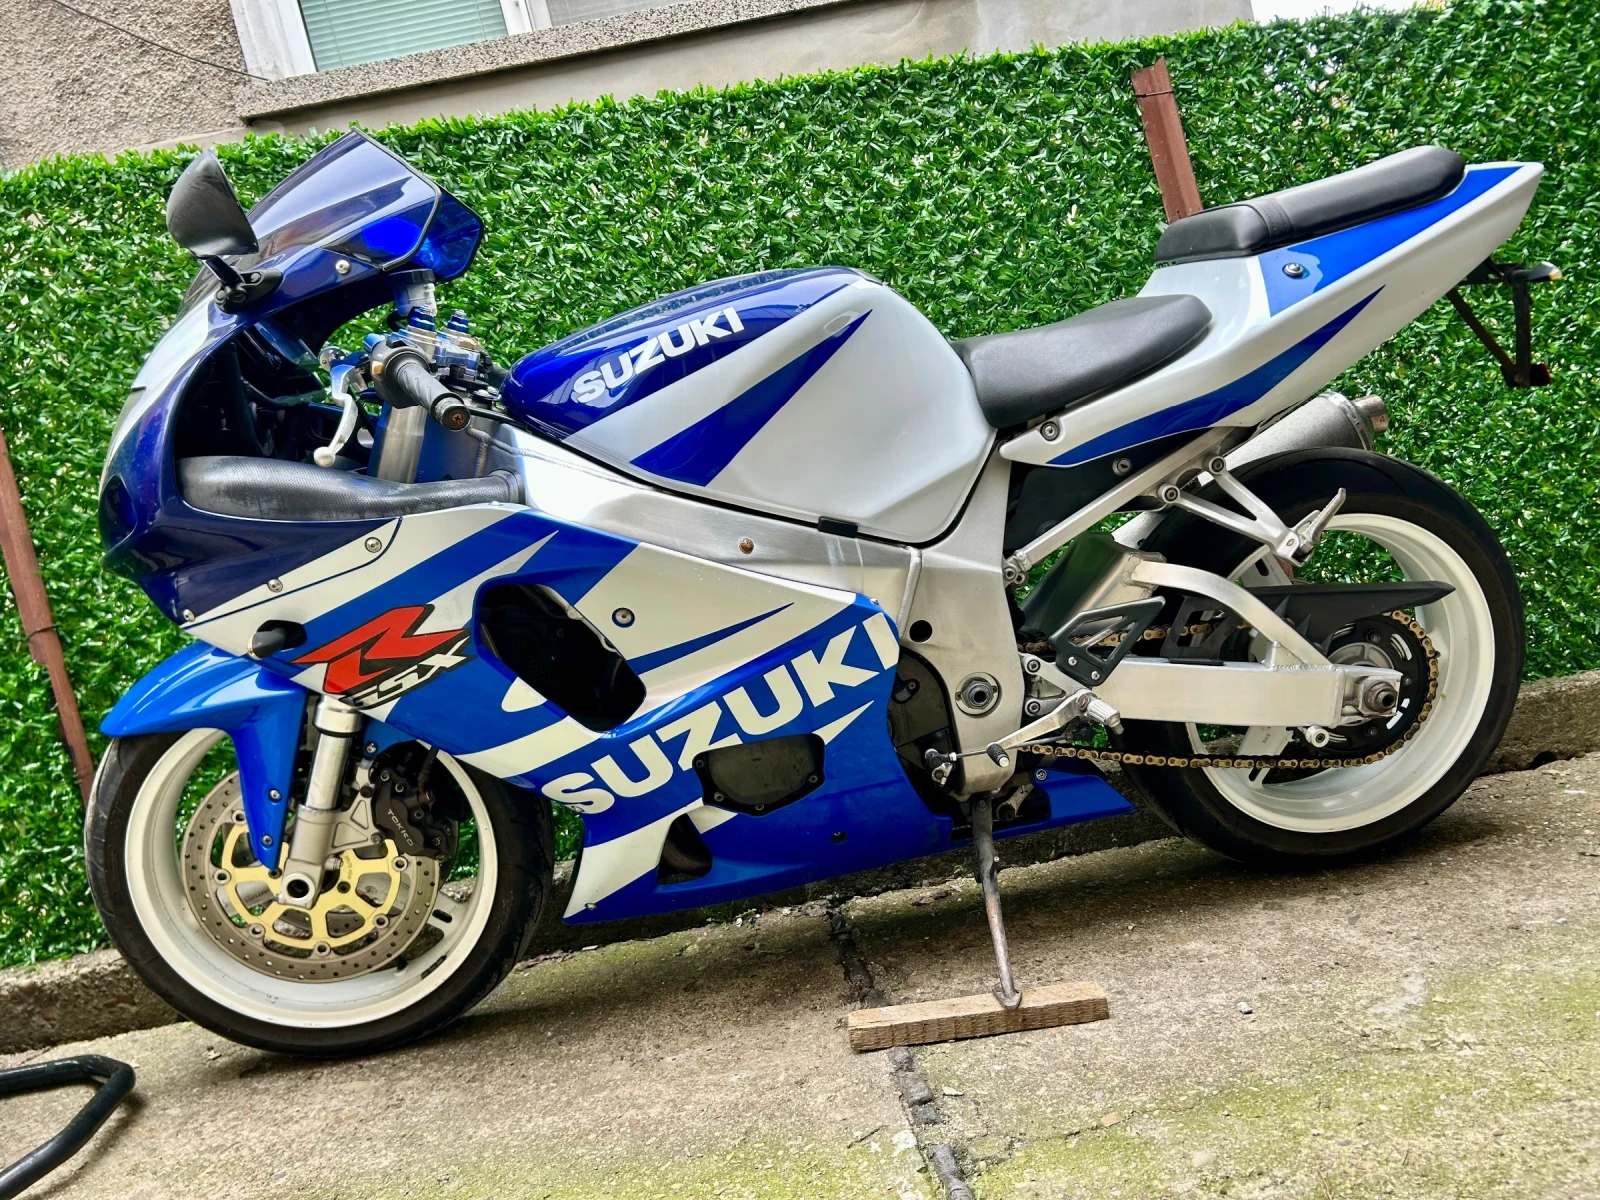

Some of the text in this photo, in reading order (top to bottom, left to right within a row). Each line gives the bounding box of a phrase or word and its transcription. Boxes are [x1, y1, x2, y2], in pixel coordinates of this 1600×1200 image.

[573, 306, 745, 404] SUZUKI
[343, 635, 471, 709] GSX
[540, 612, 900, 815] SUZUKI
[387, 808, 414, 847] TOKICO
